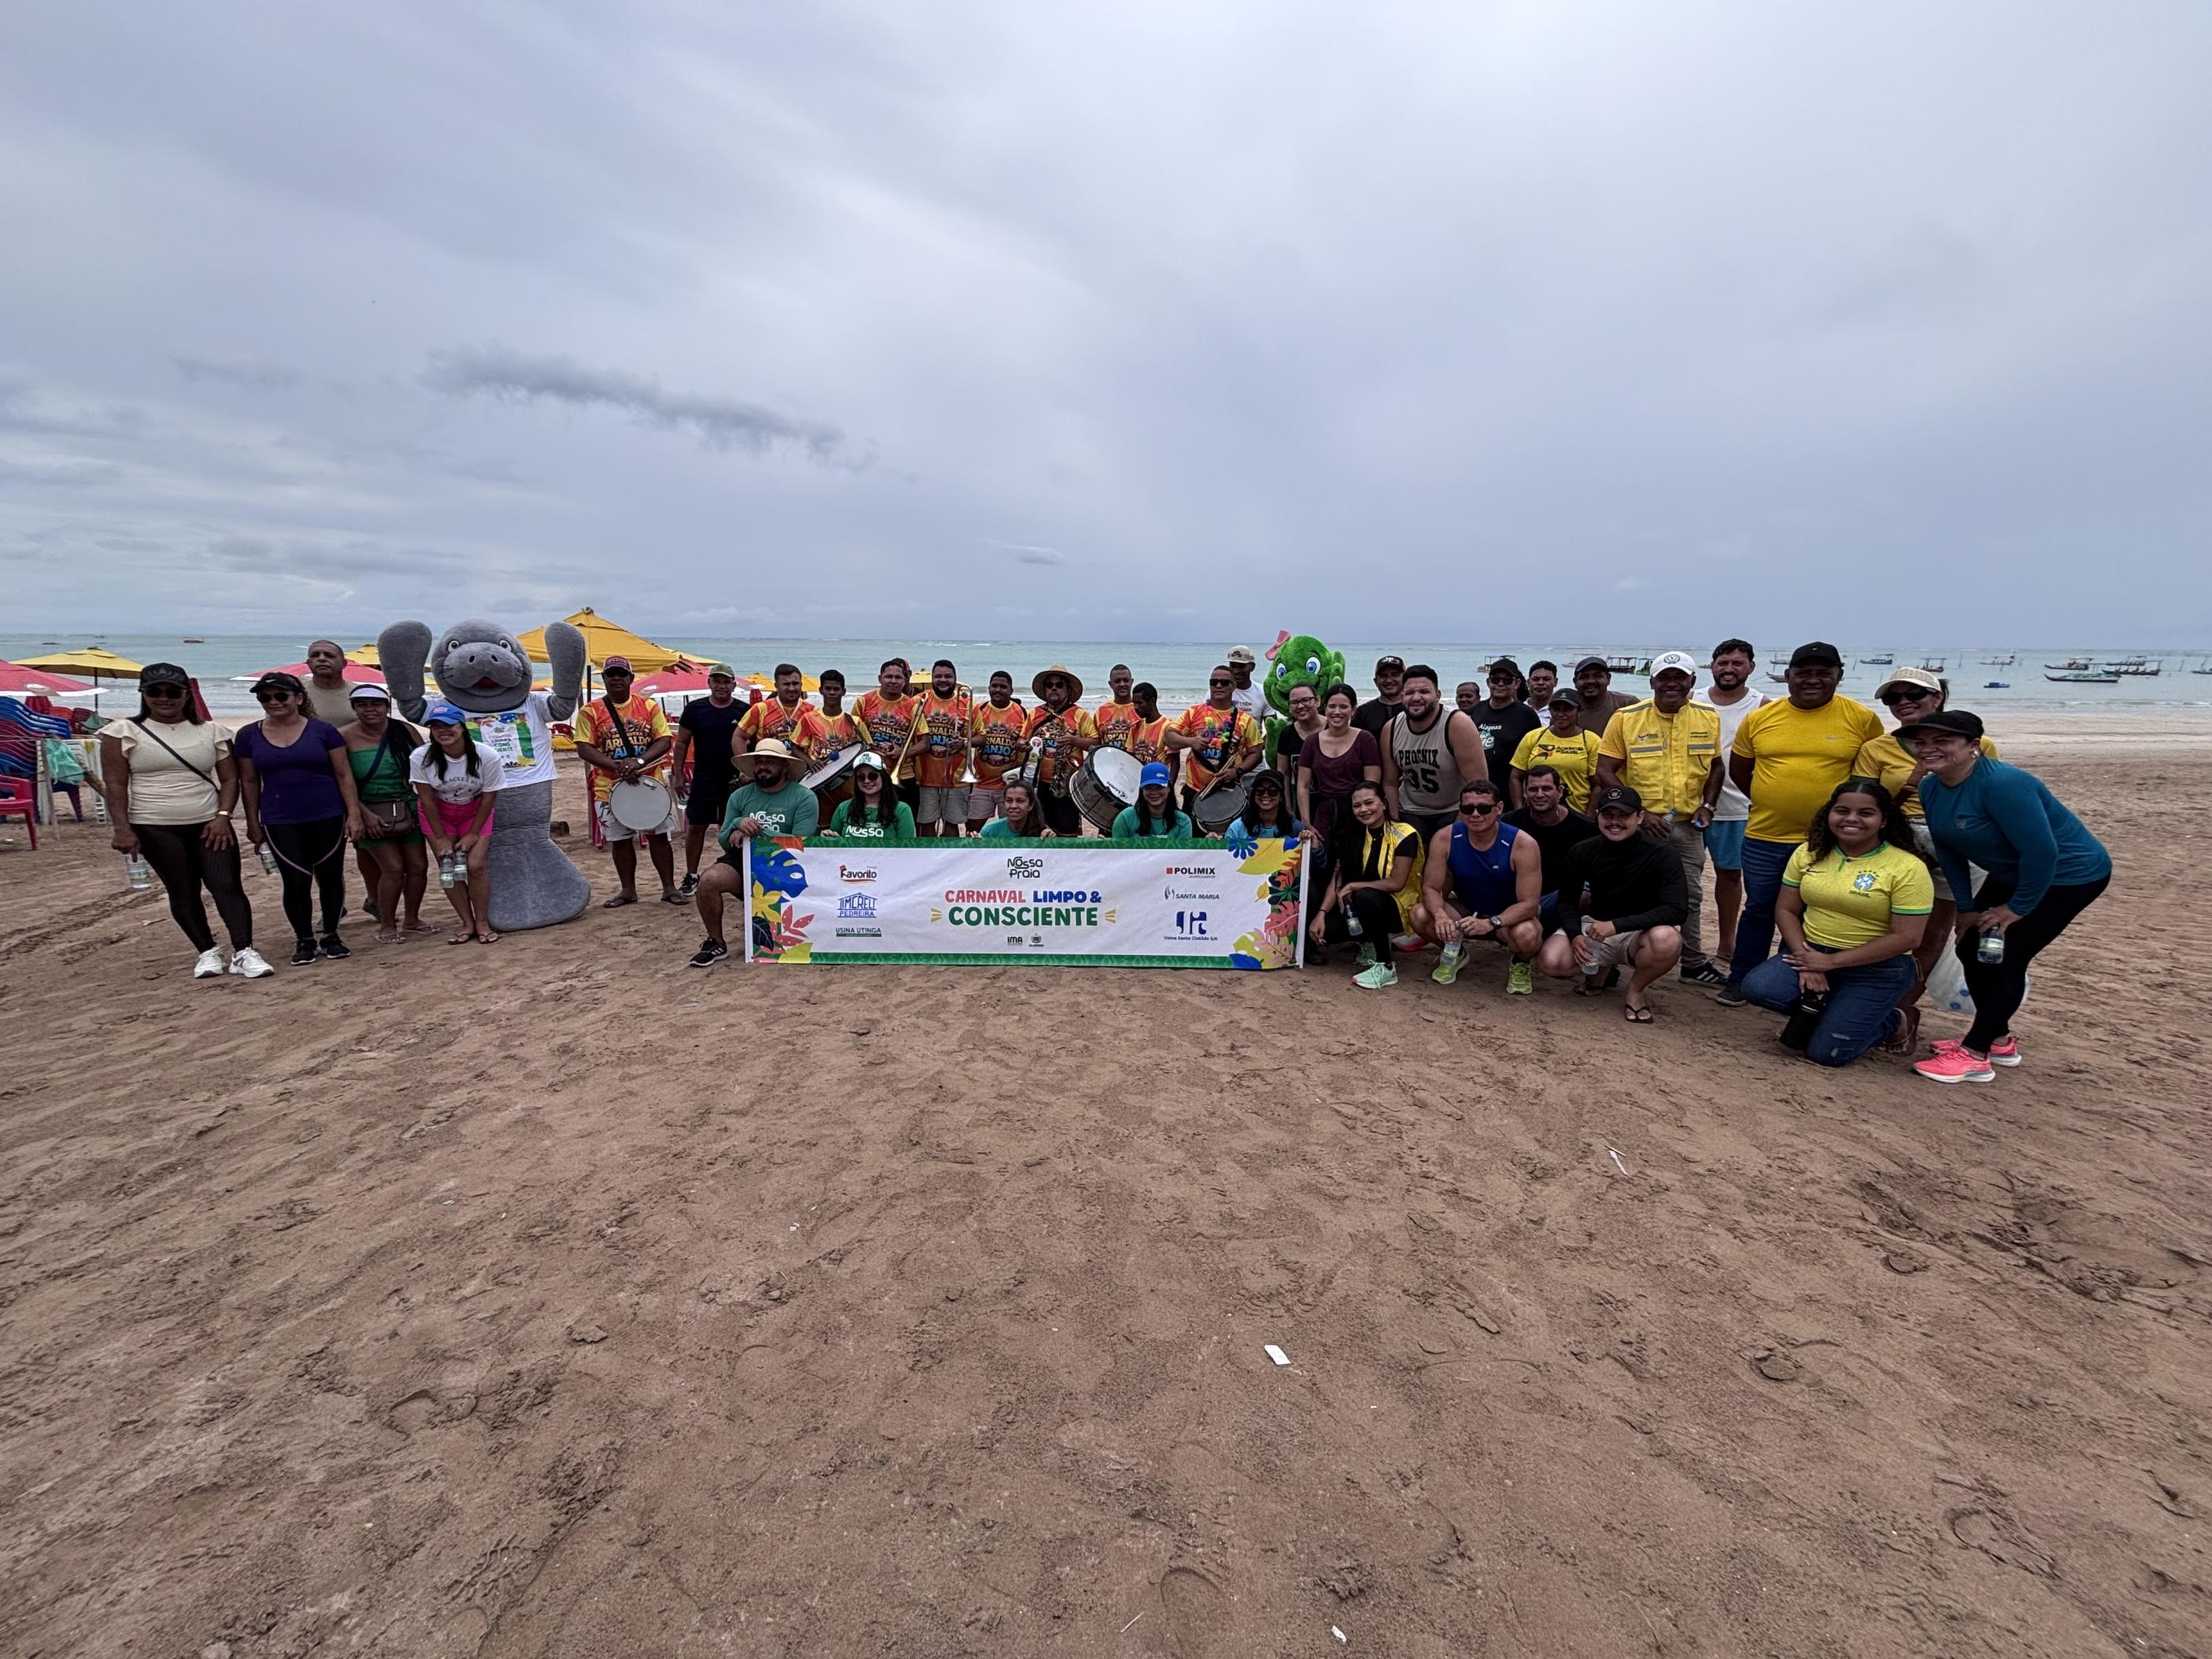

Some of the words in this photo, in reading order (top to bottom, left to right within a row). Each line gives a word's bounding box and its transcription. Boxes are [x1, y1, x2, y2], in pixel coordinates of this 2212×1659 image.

[839, 865, 877, 878] Favorito
[945, 890, 1026, 904] CARNAVAL
[1033, 890, 1087, 904] LIMPO
[1089, 890, 1102, 904] &
[948, 906, 1098, 927] CONSCIENTE
